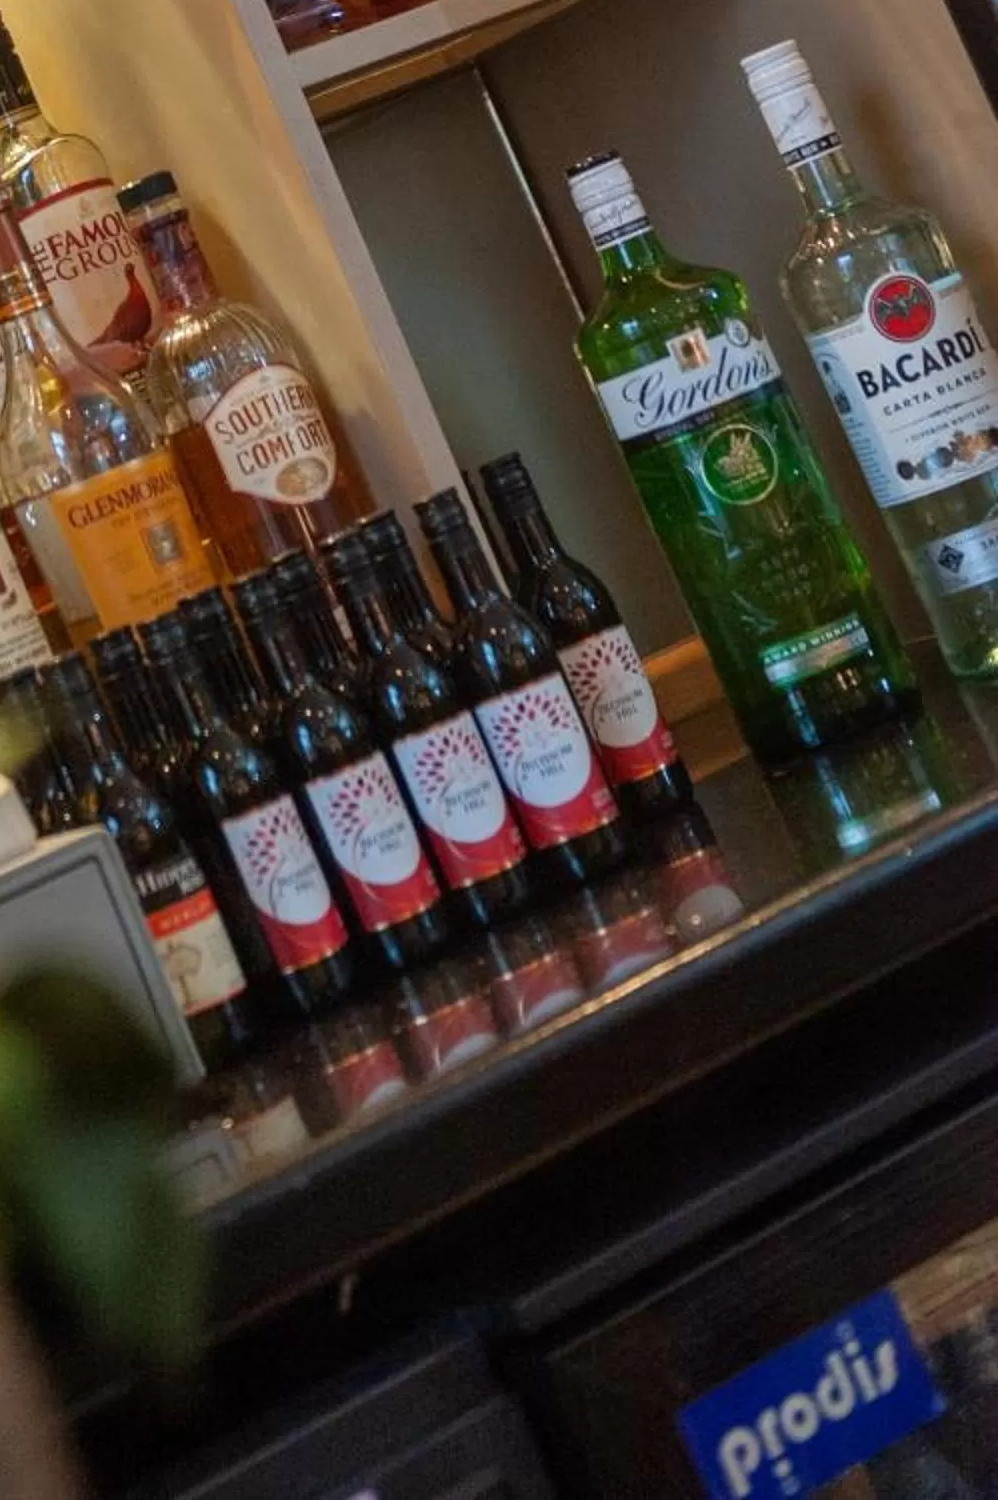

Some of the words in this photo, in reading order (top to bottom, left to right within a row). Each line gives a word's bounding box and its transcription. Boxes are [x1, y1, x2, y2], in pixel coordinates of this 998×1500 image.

[33, 242, 57, 286] THE
[622, 347, 775, 429] Gordon's
[883, 391, 932, 417] CARTA
[936, 366, 987, 395] BLANCA
[718, 1338, 899, 1498] prodis
